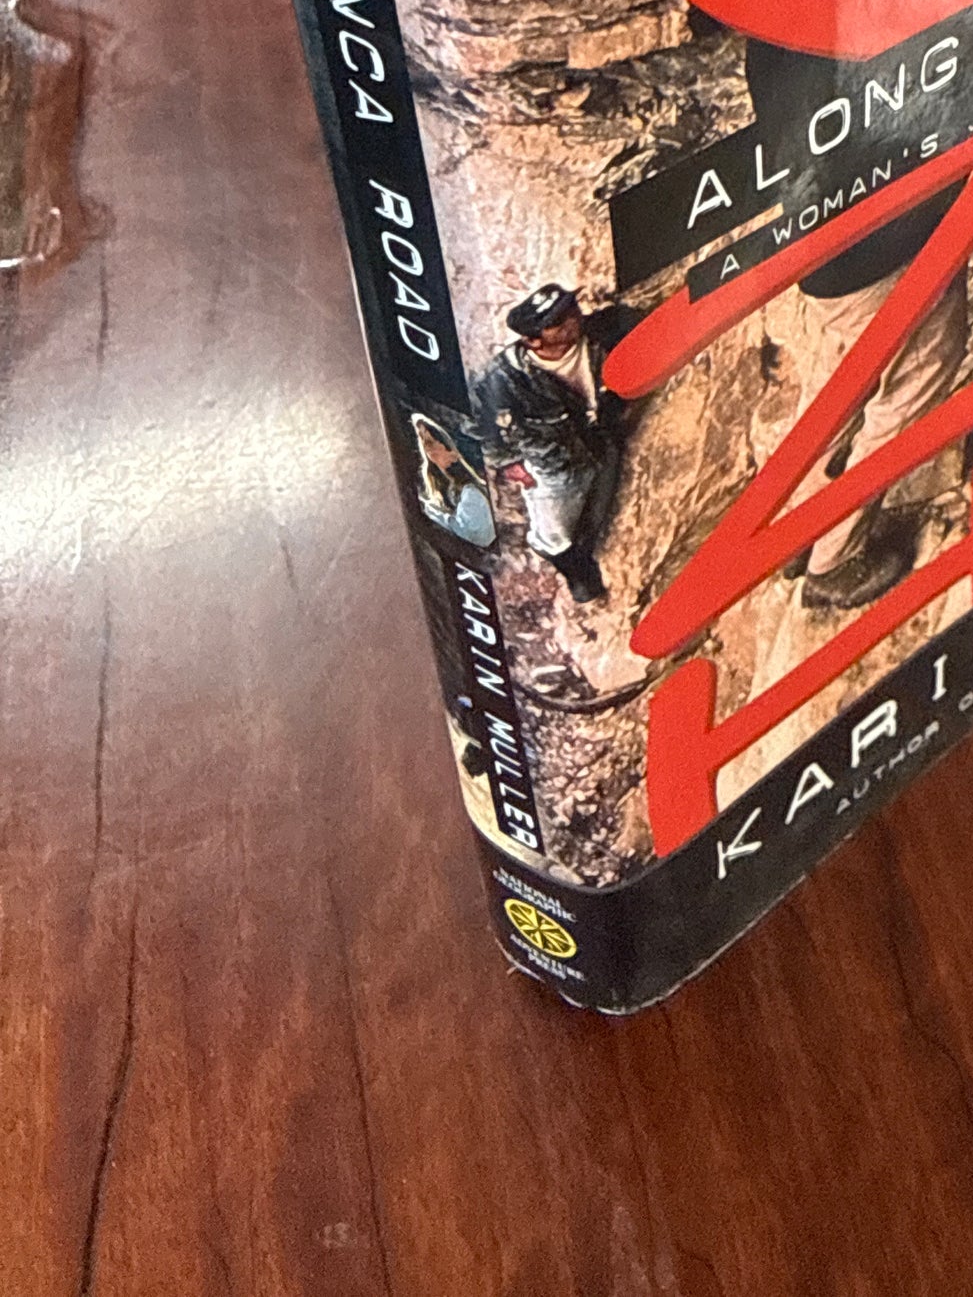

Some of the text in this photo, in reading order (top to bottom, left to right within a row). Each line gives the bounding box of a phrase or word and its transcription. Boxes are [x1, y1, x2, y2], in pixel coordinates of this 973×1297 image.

[686, 35, 960, 230] ALONG
[719, 252, 742, 281] A
[772, 132, 940, 246] WOMAN'S
[368, 178, 441, 361] ROAD
[454, 560, 540, 851] KARIN MULLER
[835, 720, 941, 816] AUTHOR
